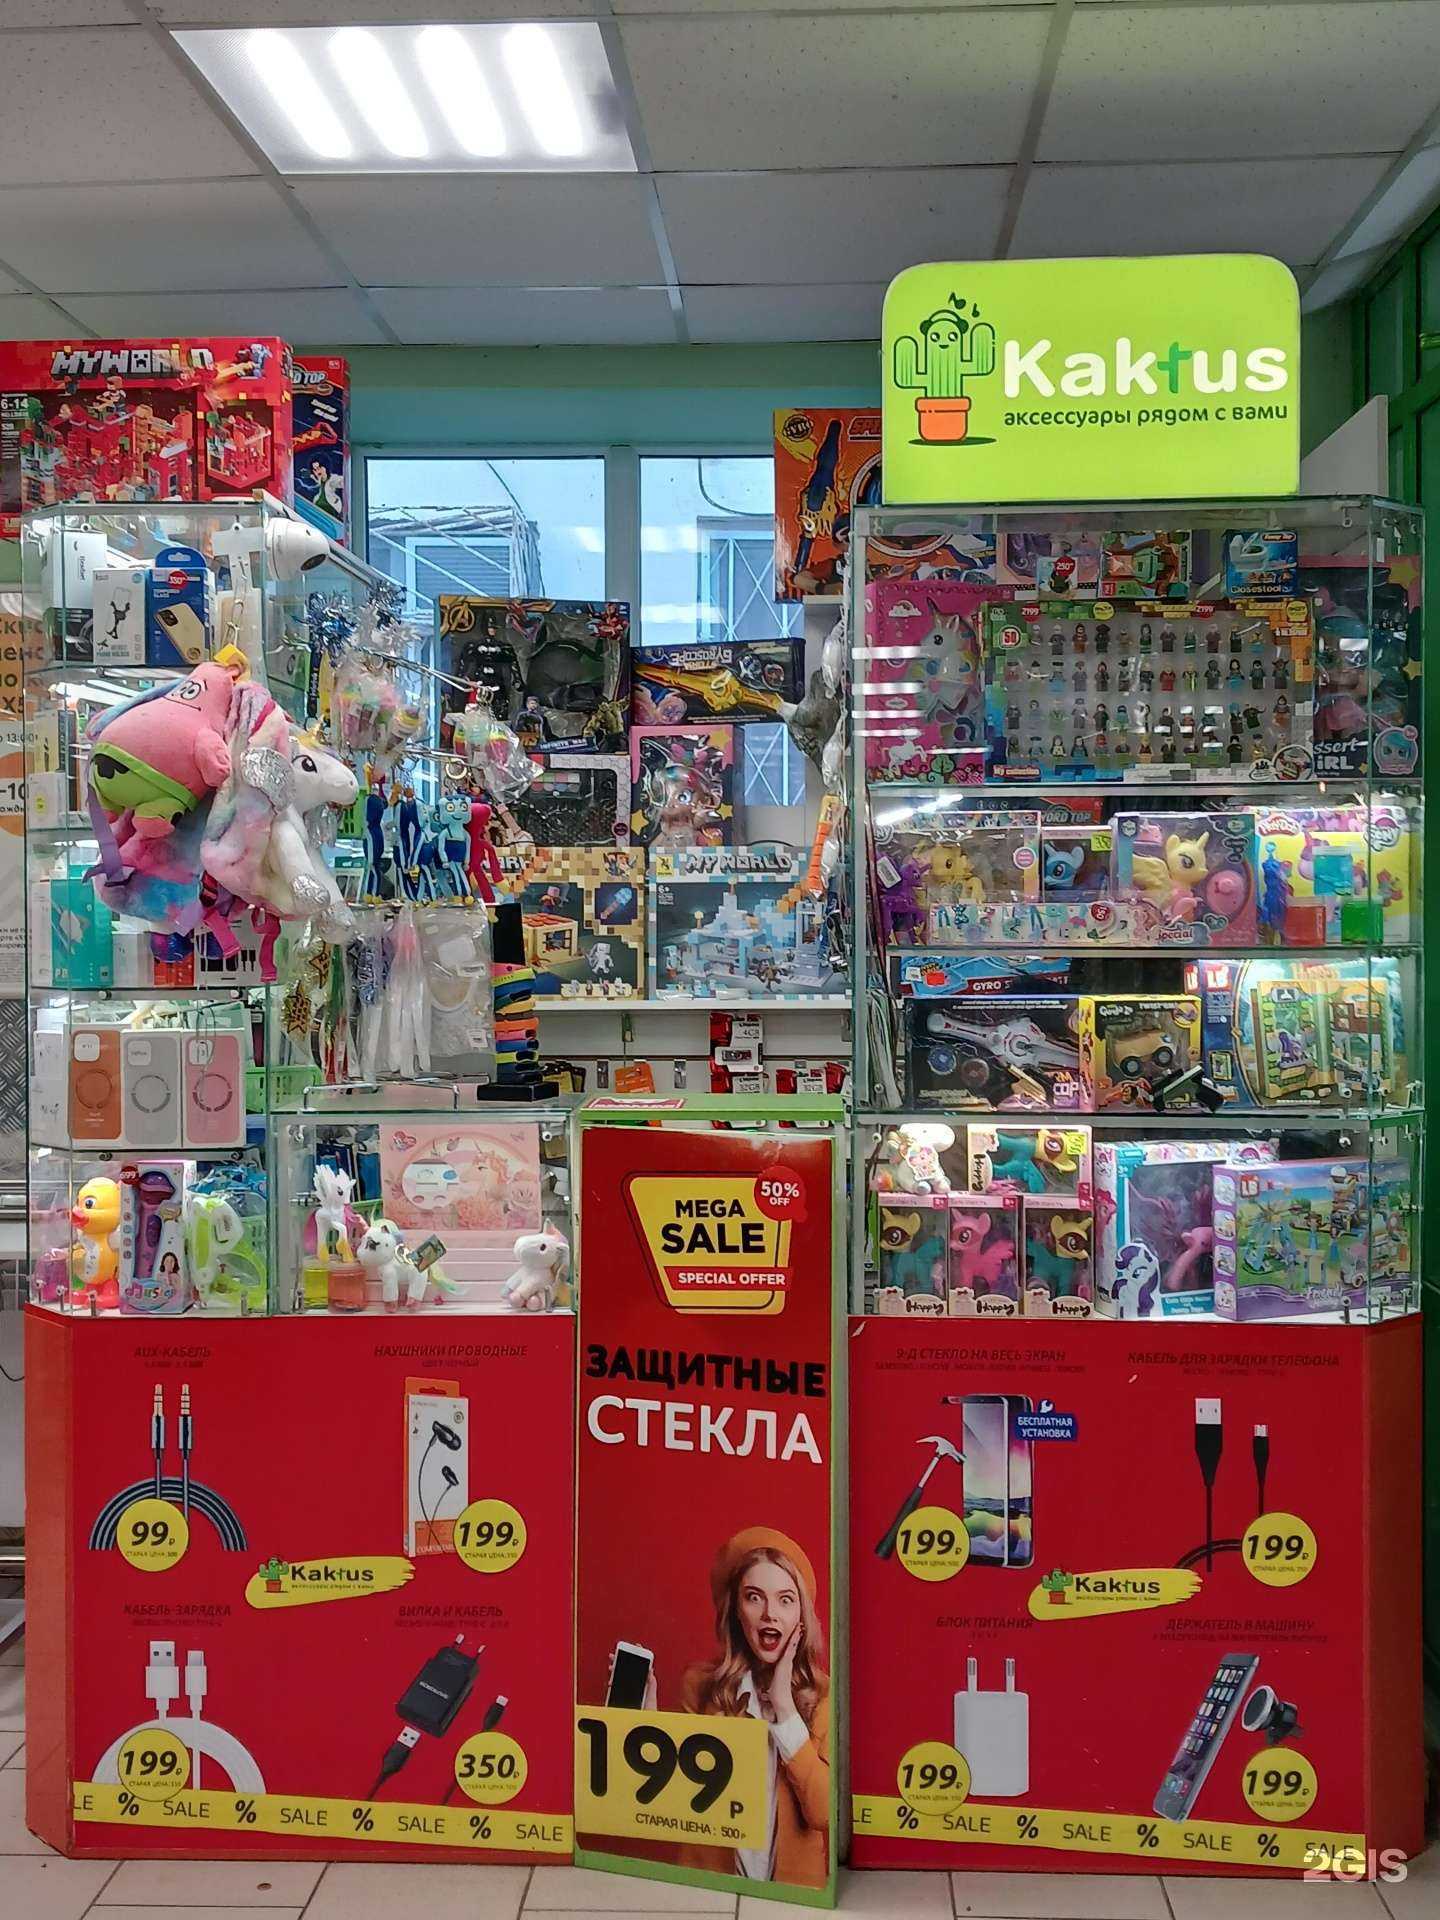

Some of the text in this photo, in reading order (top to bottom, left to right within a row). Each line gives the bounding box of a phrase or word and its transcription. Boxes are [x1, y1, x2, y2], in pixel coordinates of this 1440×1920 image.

[1003, 337, 1290, 399] Kaktus
[1004, 403, 1289, 429] аксессуары рядом с вами
[1004, 632, 1017, 644] 50
[720, 854, 793, 875] WORLD
[973, 983, 1001, 991] GYRO
[760, 1181, 799, 1198] 50%
[675, 1199, 745, 1218] MEGA
[769, 1196, 790, 1206] OFF
[661, 1223, 766, 1254] SALE
[678, 1272, 786, 1286] SPECIAL OFFER
[906, 1299, 944, 1316] Happy
[976, 1300, 1015, 1316] Happy
[1052, 1301, 1091, 1318] Happy
[374, 1345, 528, 1358] НАУШНИКИ ПРОВОДНЫЕ
[920, 1350, 969, 1361] СТЕКЛО
[972, 1350, 990, 1361] НА
[992, 1351, 1023, 1362] ВЕСЬ
[1025, 1351, 1066, 1362] ЭКРАН
[1128, 1352, 1340, 1367] КАБЕЛЬ ДЛЯ ЗАРЯДКИ ТЕЛЕФОНА
[585, 1345, 826, 1398] ЗАЩИТНЫЕ
[587, 1395, 822, 1464] СТЕКЛА
[1018, 1416, 1073, 1428] БЕСПЛАТНАЯ
[1022, 1428, 1072, 1439] УСТАНОВКА
[291, 1565, 374, 1582] Kaktus
[1075, 1576, 1161, 1594] Kaktus
[399, 1606, 441, 1617] ВИЛКА
[454, 1606, 503, 1617] КАБЕЛЬ
[936, 1616, 1034, 1629] БЛОК ПИТАНИЯ
[577, 1718, 734, 1814] 199
[163, 1800, 210, 1818] SALE
[235, 1800, 257, 1824] %
[280, 1807, 328, 1826] SALE
[352, 1808, 374, 1832] %
[398, 1815, 446, 1834] SALE
[469, 1815, 492, 1840] %
[516, 1824, 563, 1843] SALE
[635, 1814, 678, 1830] СТАРАЯ
[721, 1826, 740, 1840] 500
[943, 1814, 991, 1833] SALE
[1016, 1815, 1039, 1839] %
[1062, 1823, 1112, 1842] SALE
[1137, 1823, 1160, 1849] %
[1184, 1832, 1232, 1852] SALE
[1257, 1833, 1280, 1858] %
[1305, 1841, 1355, 1861] SALE
